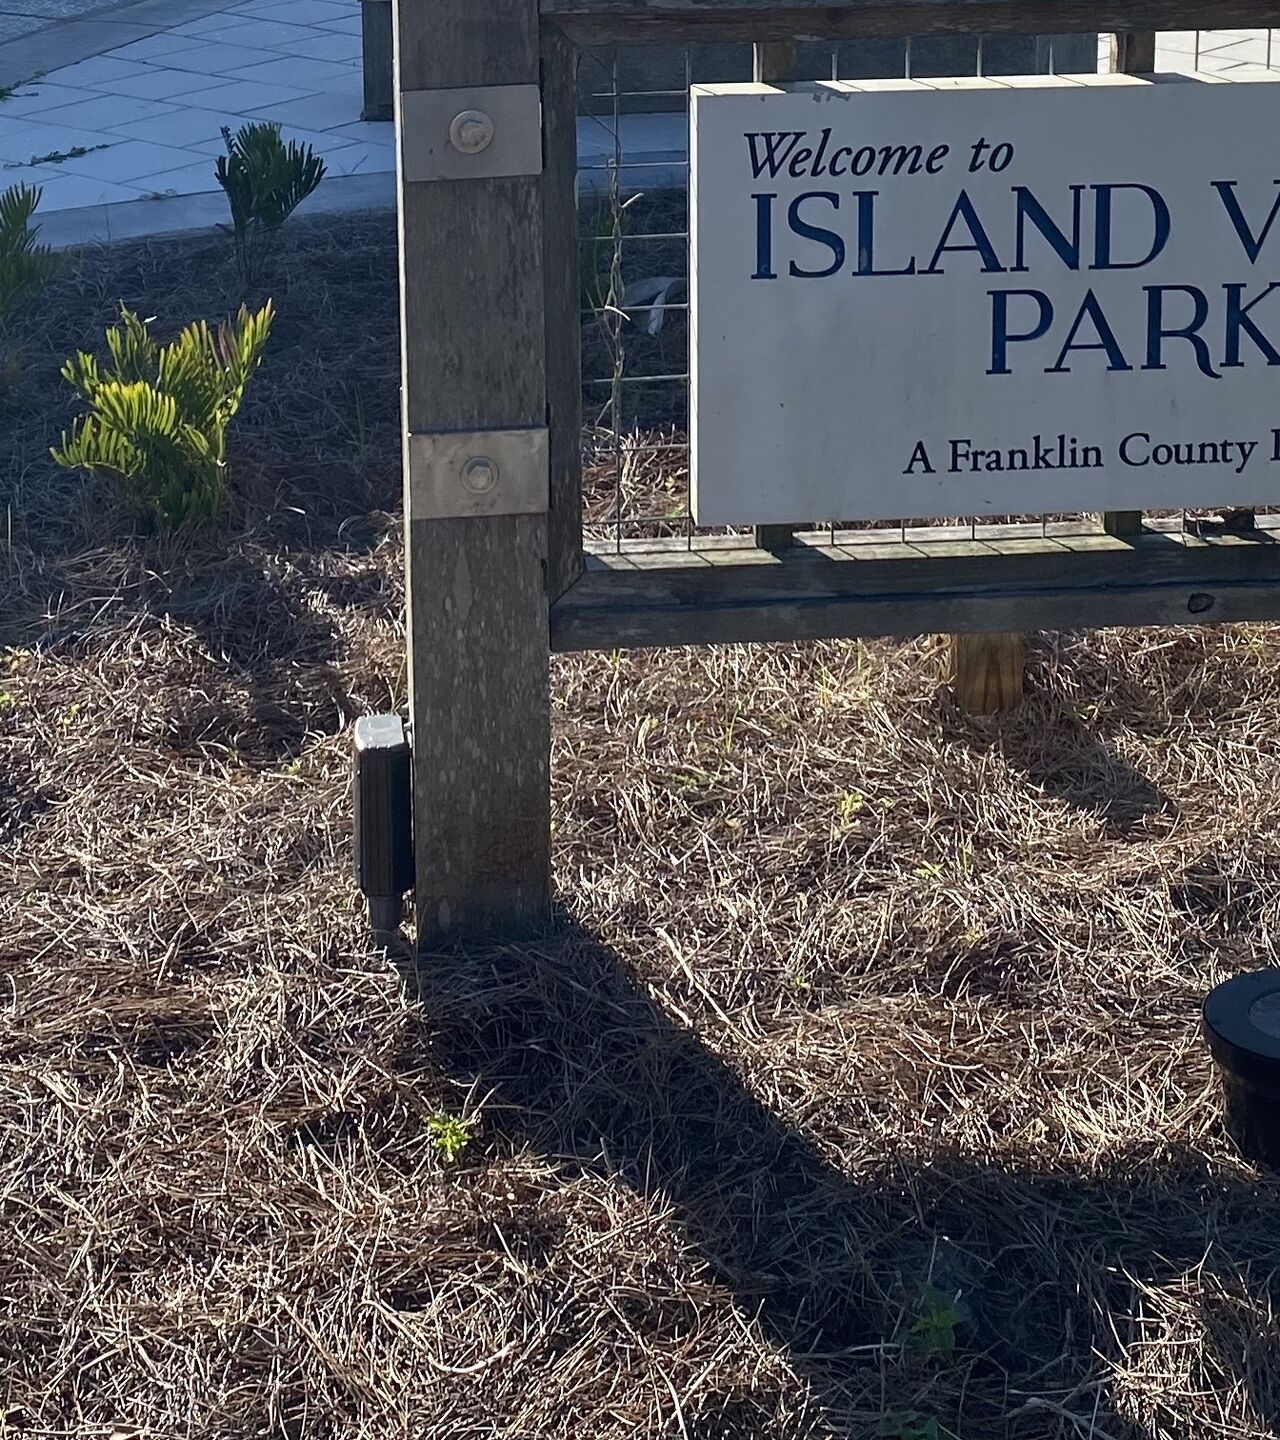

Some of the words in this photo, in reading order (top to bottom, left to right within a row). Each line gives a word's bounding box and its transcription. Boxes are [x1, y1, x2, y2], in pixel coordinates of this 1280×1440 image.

[742, 128, 947, 180] Welcome
[968, 136, 1014, 173] to
[749, 183, 1171, 280] ISLAND
[903, 440, 936, 476] A
[947, 433, 1104, 473] Franklin
[1118, 431, 1258, 473] County
